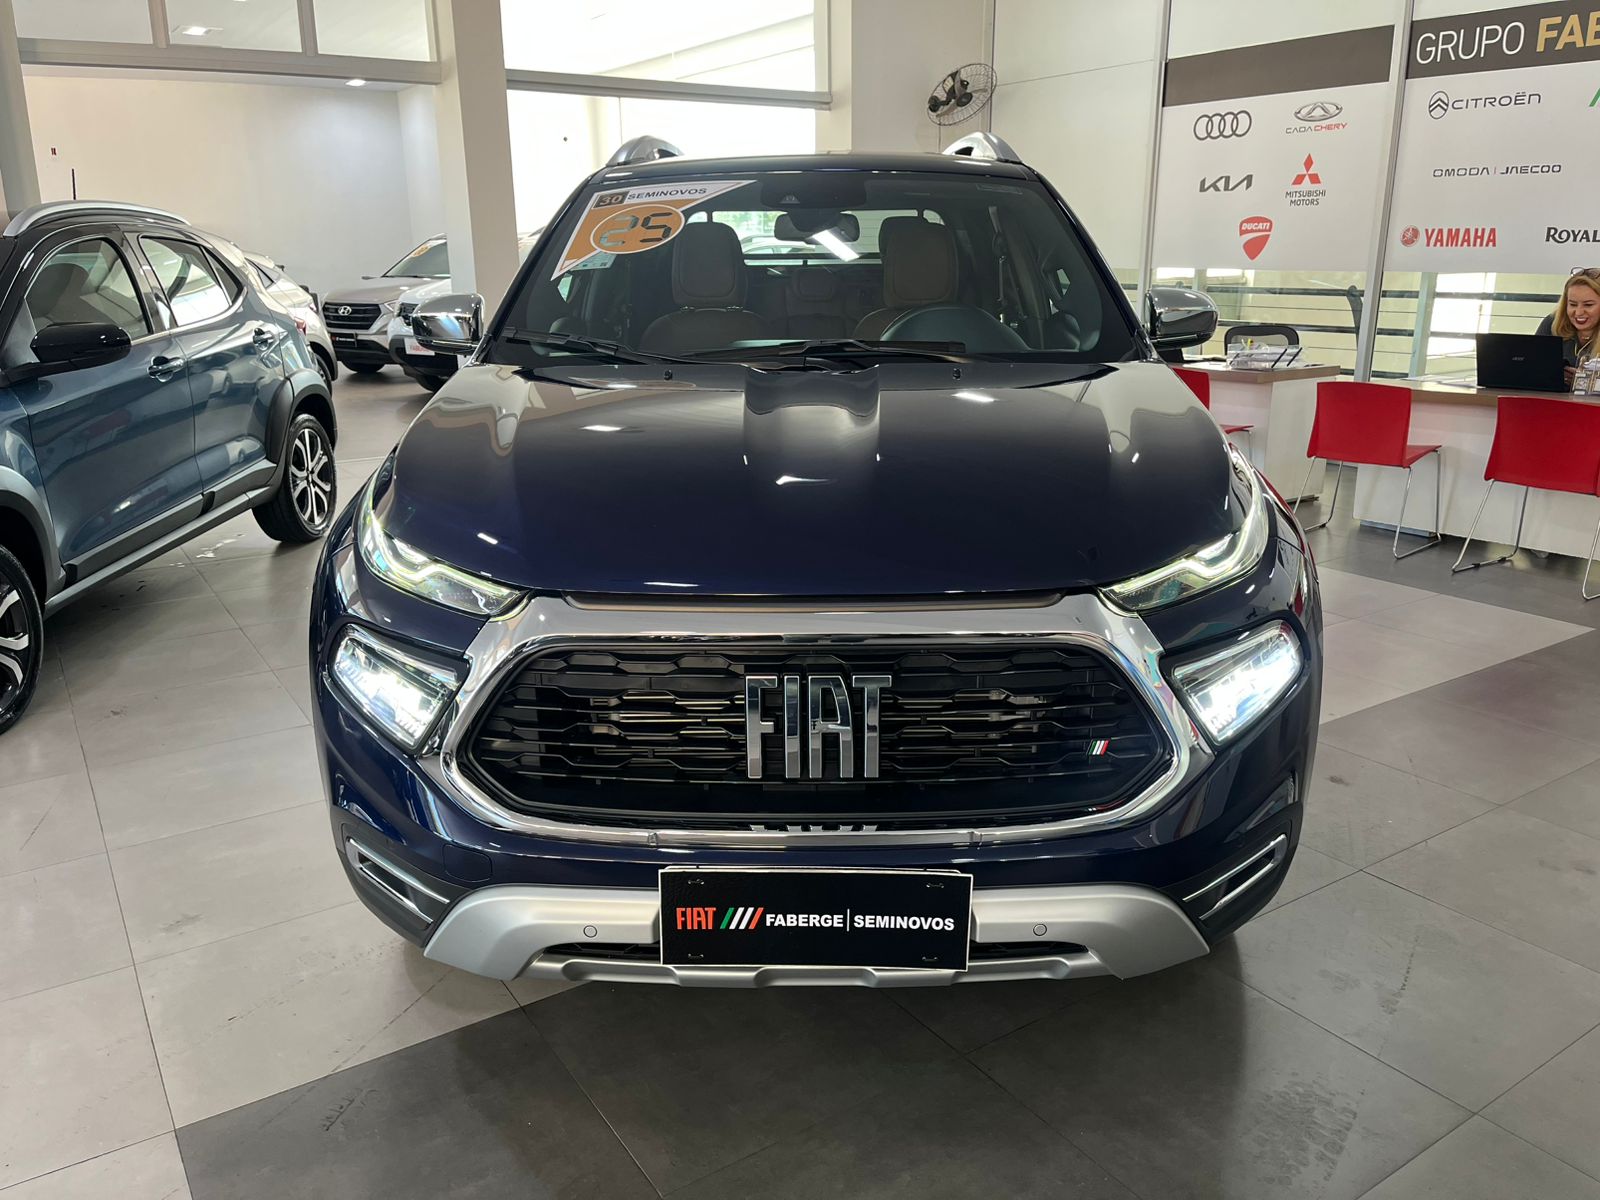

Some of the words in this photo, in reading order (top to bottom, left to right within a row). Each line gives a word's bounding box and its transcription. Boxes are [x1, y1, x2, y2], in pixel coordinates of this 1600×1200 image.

[1416, 22, 1525, 64] GRUPO
[1451, 92, 1542, 110] CITROËN
[1313, 123, 1347, 132] CHERY
[1432, 167, 1490, 178] OMODA
[1500, 164, 1562, 175] JAECOO
[1199, 174, 1253, 192] KIA
[627, 188, 707, 200] SEMINOVOS
[1285, 190, 1326, 199] MITSUBISHI
[1289, 198, 1320, 207] MOTORS
[600, 212, 673, 247] 25
[1241, 222, 1270, 231] DUCATI
[1424, 227, 1497, 248] YAMAHA
[1545, 226, 1600, 244] ROYAL
[745, 675, 892, 779] FIAT
[676, 907, 716, 930] FIAT
[765, 912, 843, 928] FABERGE
[853, 914, 954, 931] SEMINOVOS
